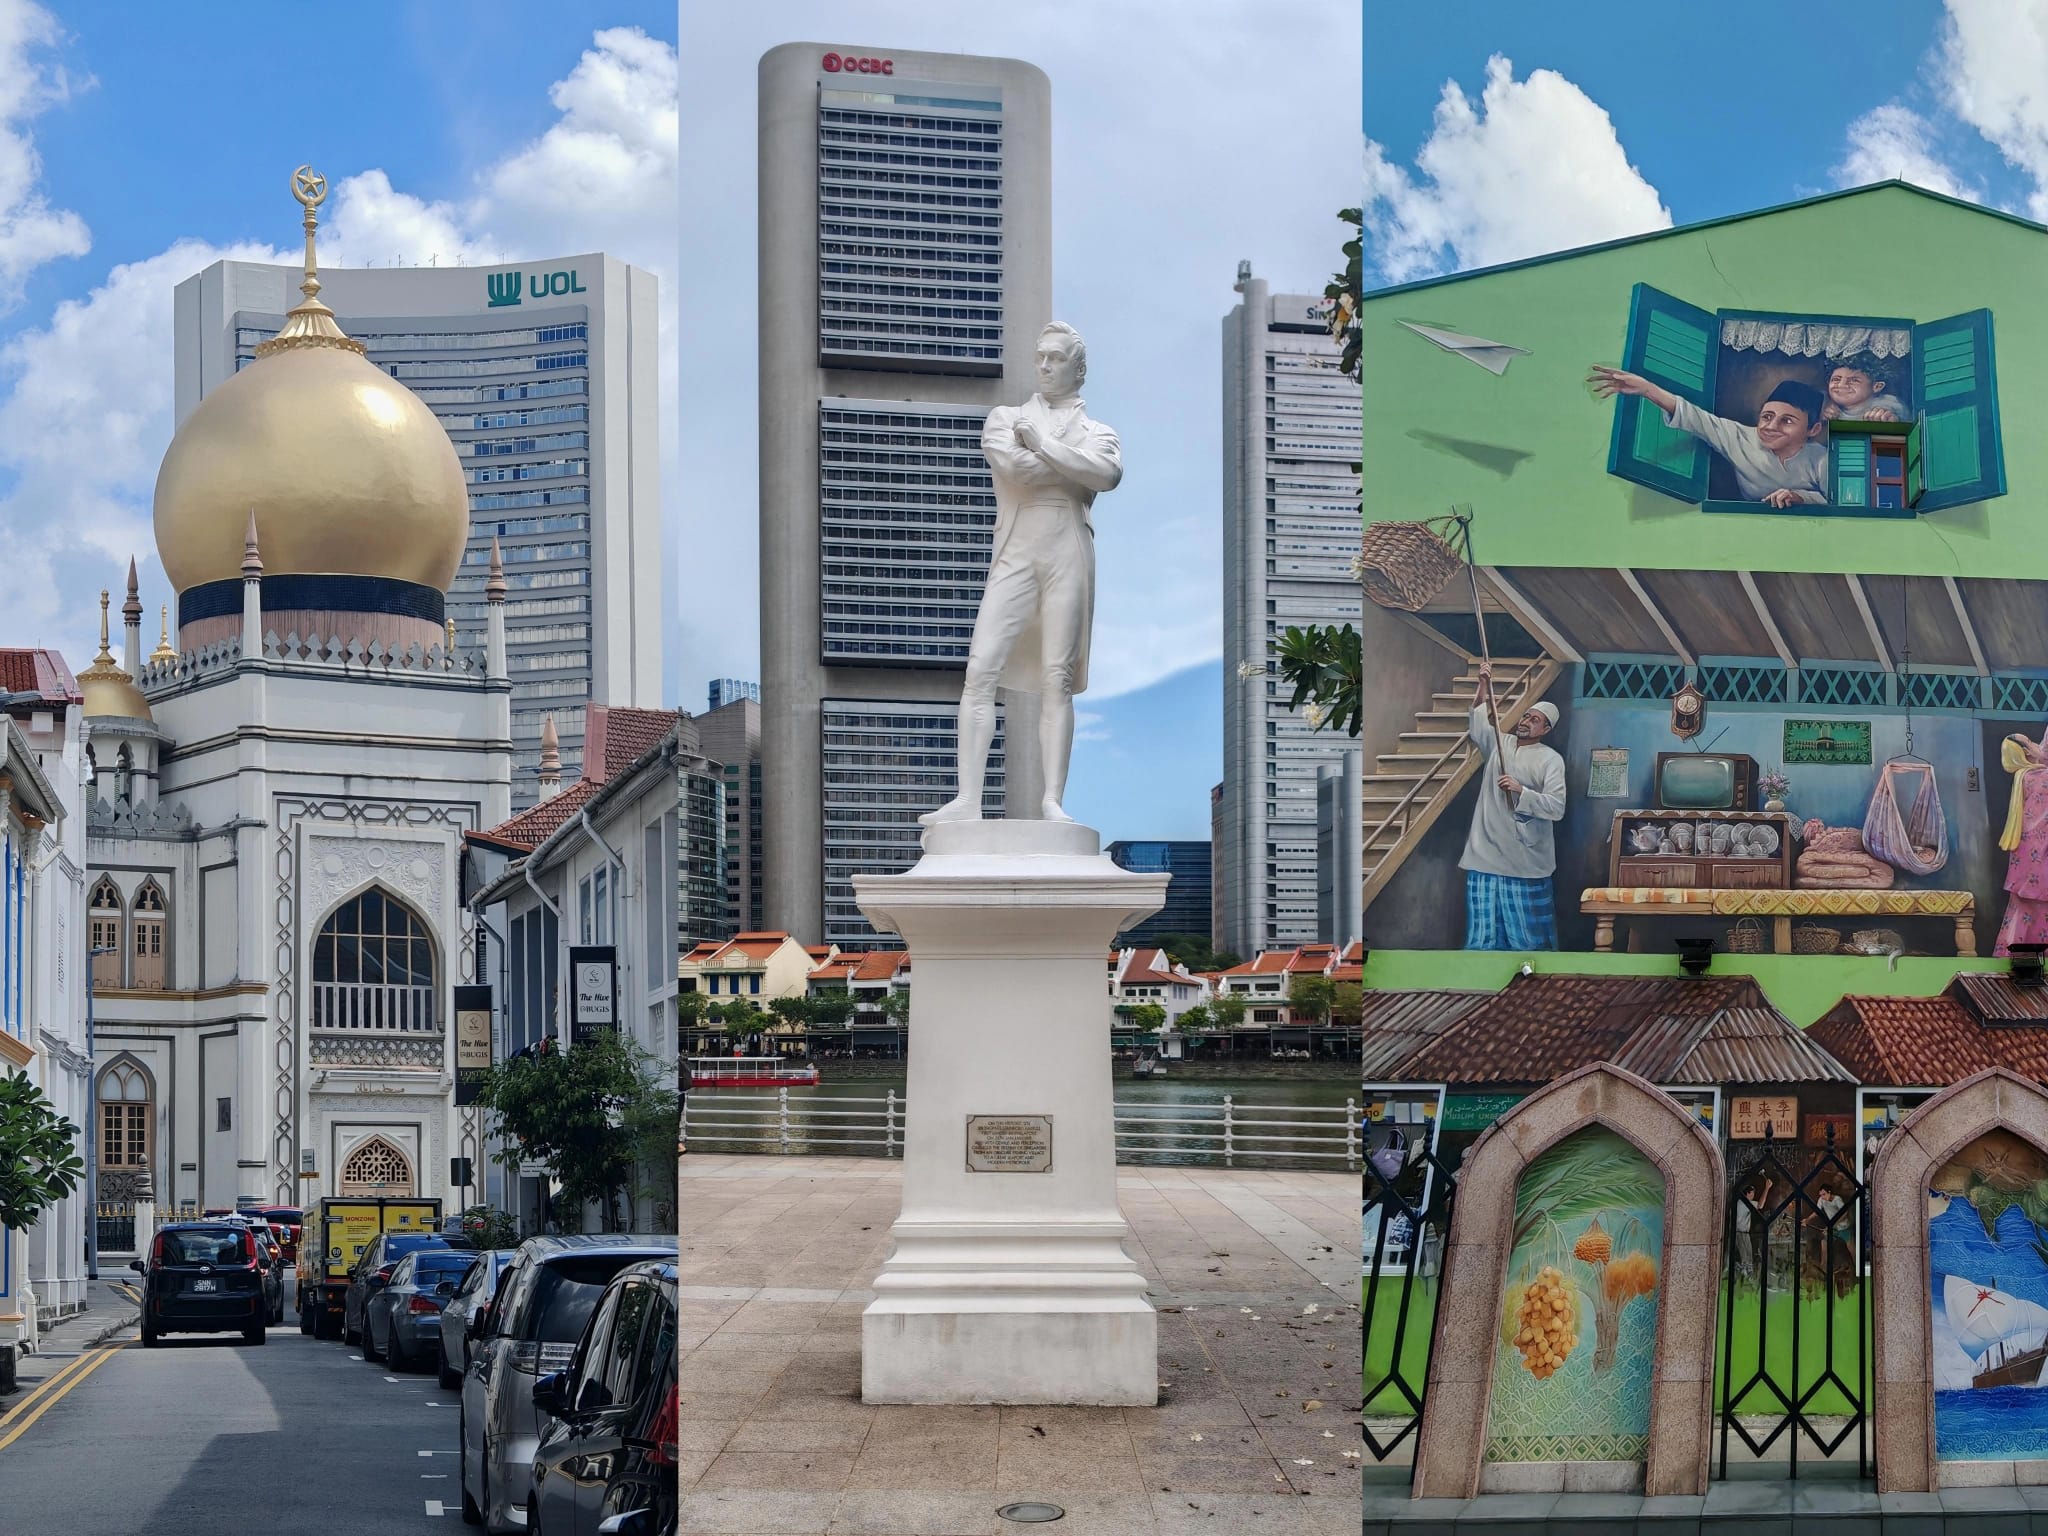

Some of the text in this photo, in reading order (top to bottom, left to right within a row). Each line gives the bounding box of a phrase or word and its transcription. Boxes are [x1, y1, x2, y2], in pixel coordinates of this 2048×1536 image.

[844, 56, 893, 75] OCBC
[530, 270, 587, 298] UOL
[580, 993, 610, 1002] The Hive
[474, 1040, 489, 1048] Hive
[1735, 1121, 1793, 1133] LEE LO HIN
